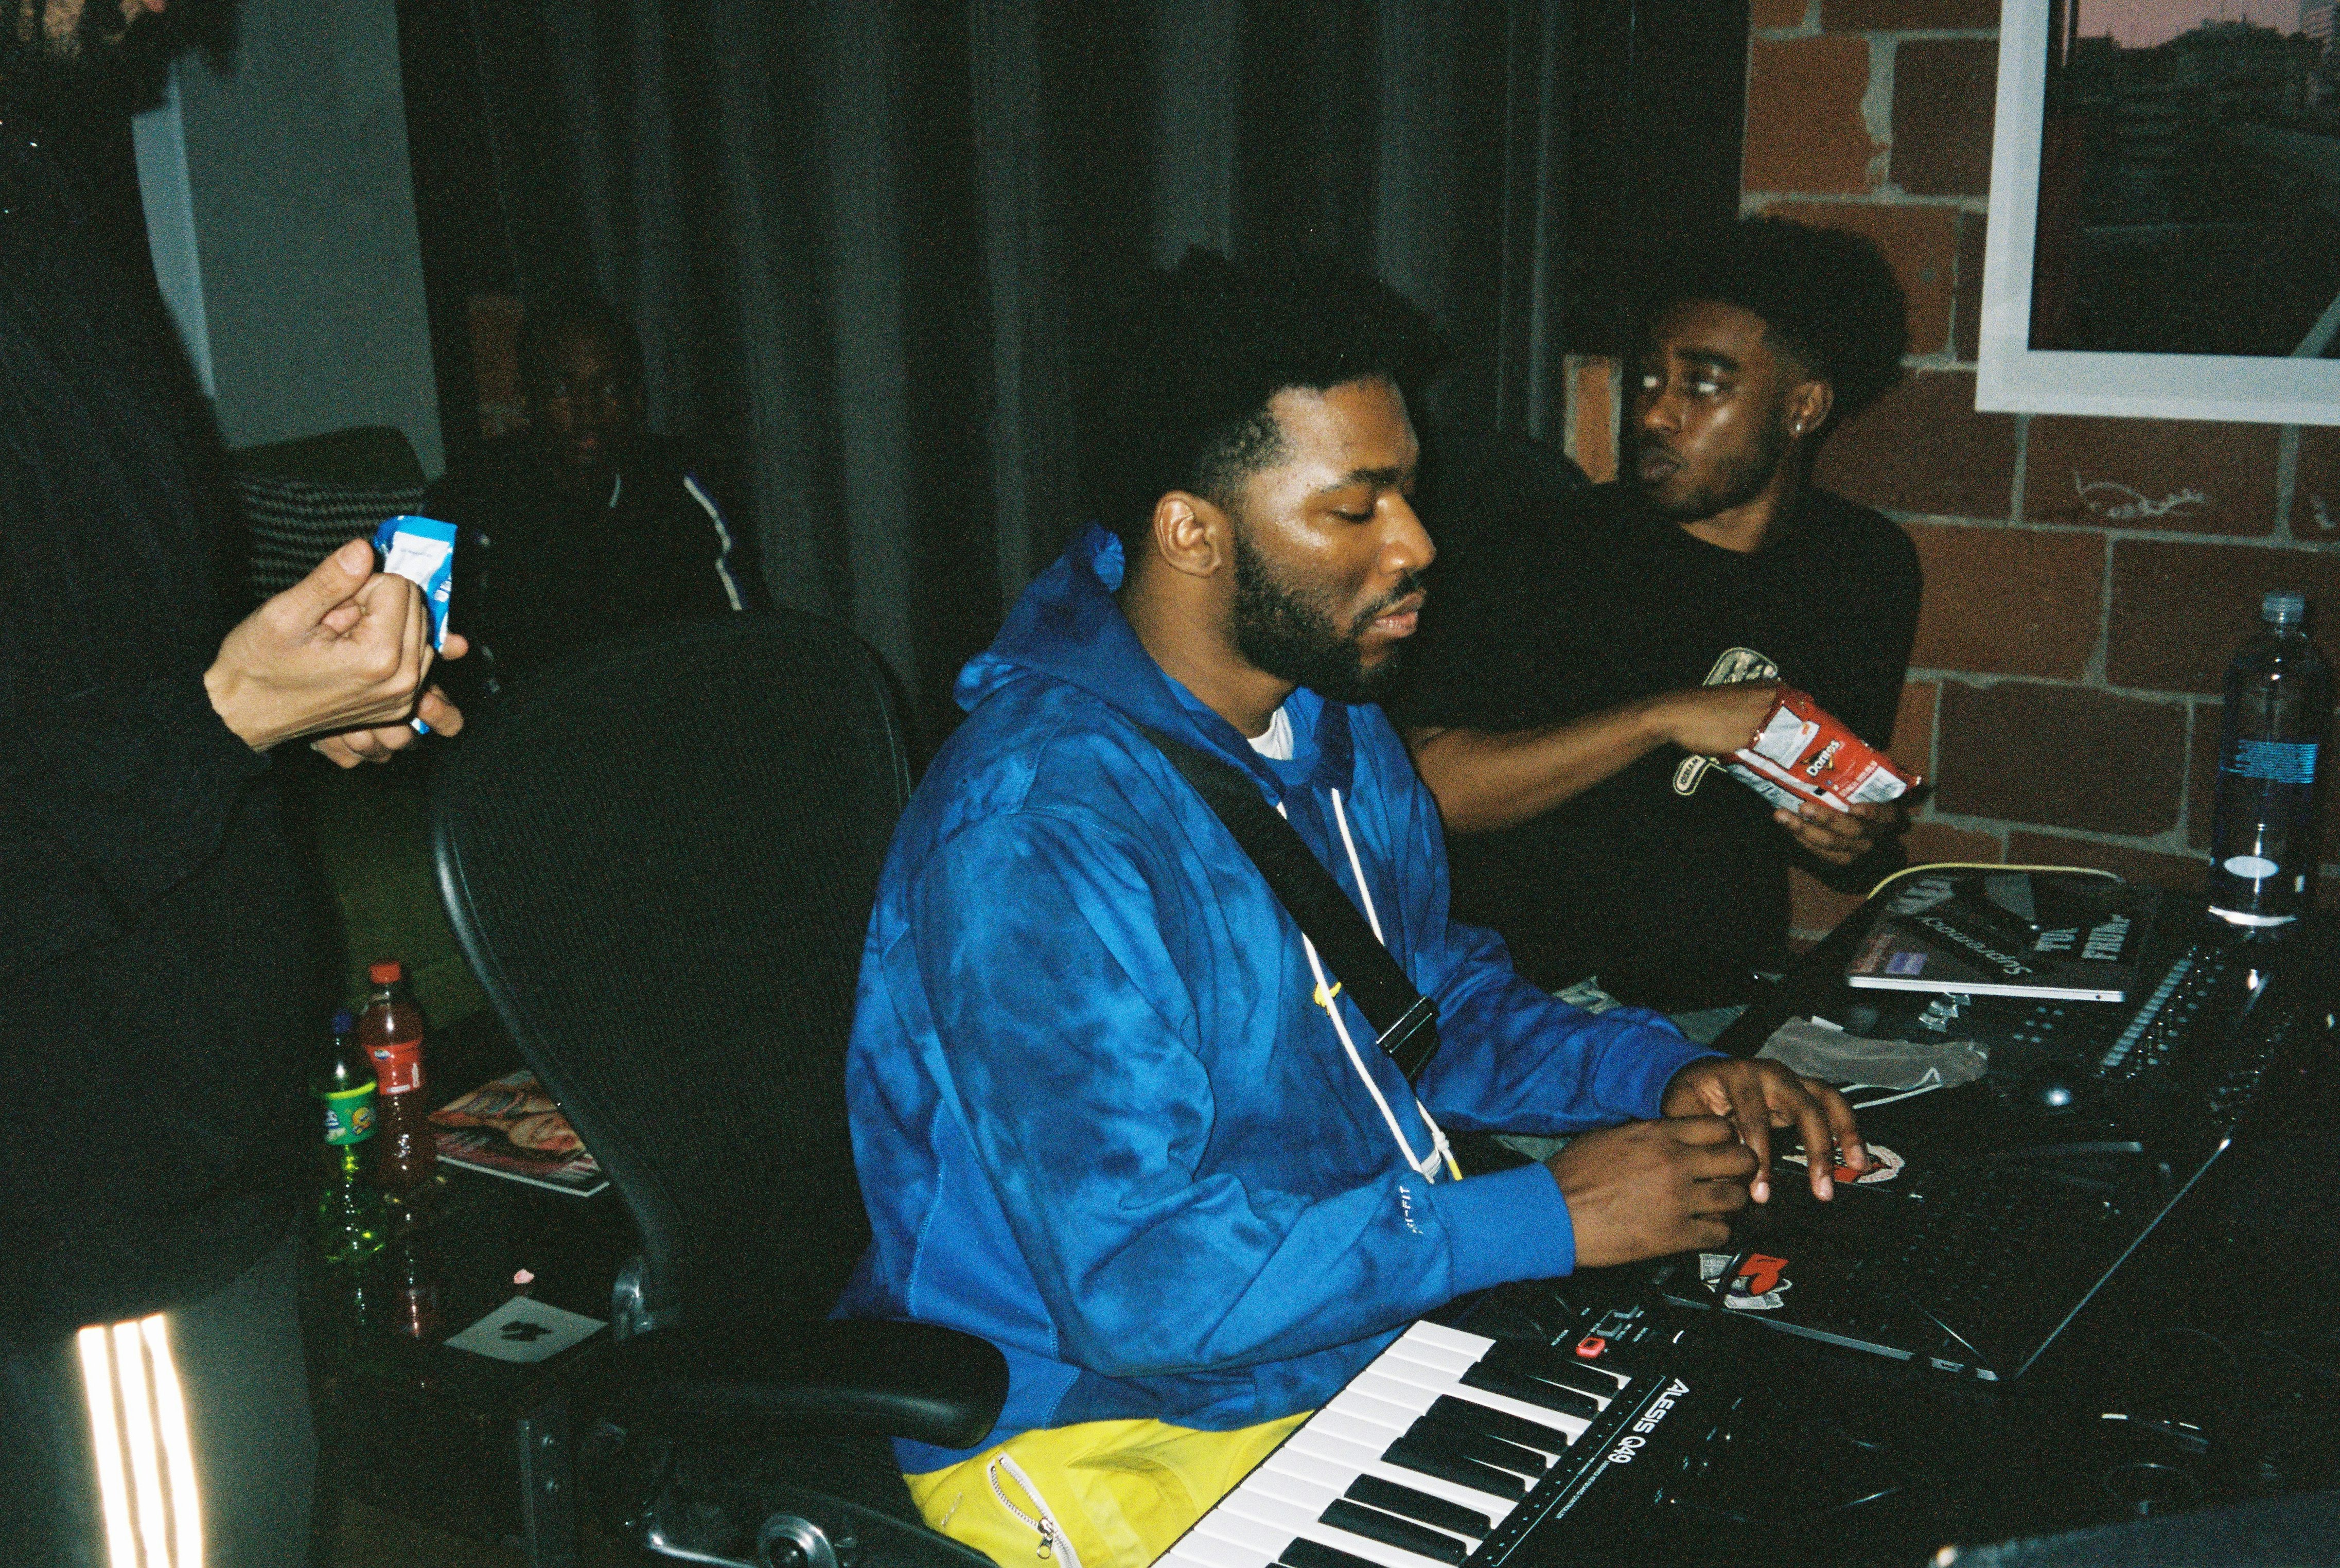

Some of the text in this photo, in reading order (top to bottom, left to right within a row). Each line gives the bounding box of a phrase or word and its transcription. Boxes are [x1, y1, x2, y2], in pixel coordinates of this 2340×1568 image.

[1806, 739, 1841, 776] Doritos
[1607, 1378, 1690, 1464] ALESIS Q49
